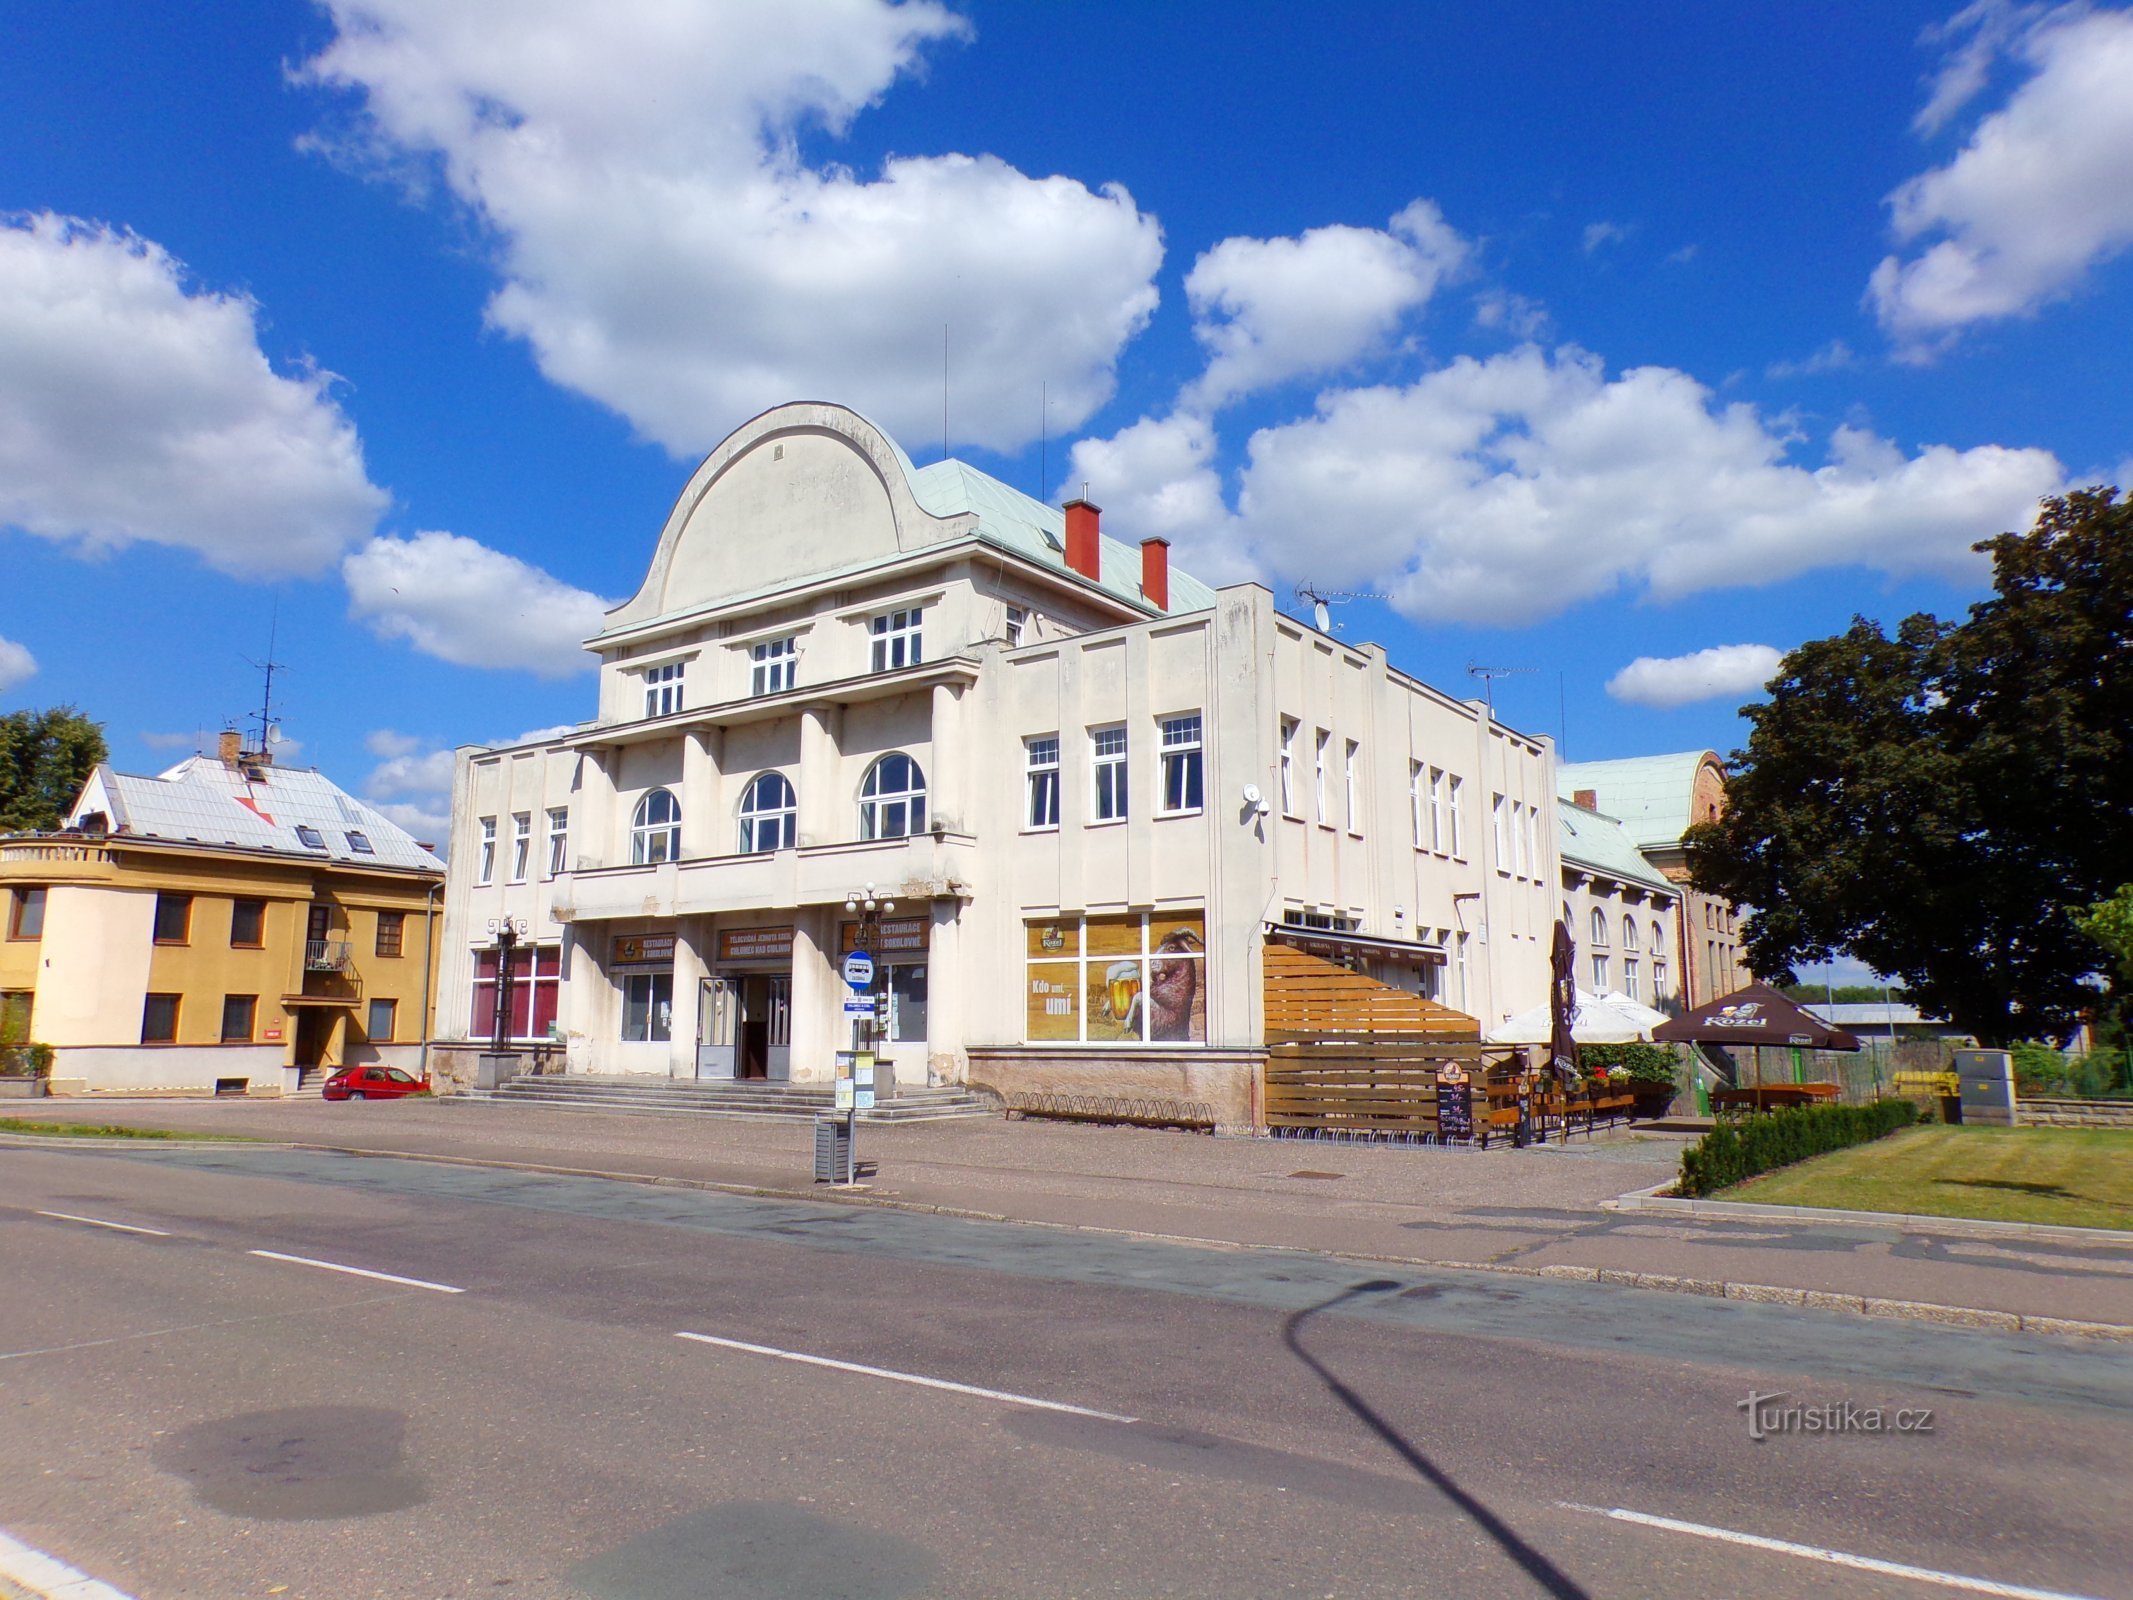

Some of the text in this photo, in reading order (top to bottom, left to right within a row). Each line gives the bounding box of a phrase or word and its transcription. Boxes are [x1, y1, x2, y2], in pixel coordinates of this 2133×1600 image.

[1032, 979, 1049, 993] Kdo
[1045, 993, 1072, 1015] umí
[1703, 1016, 1767, 1028] Kozel
